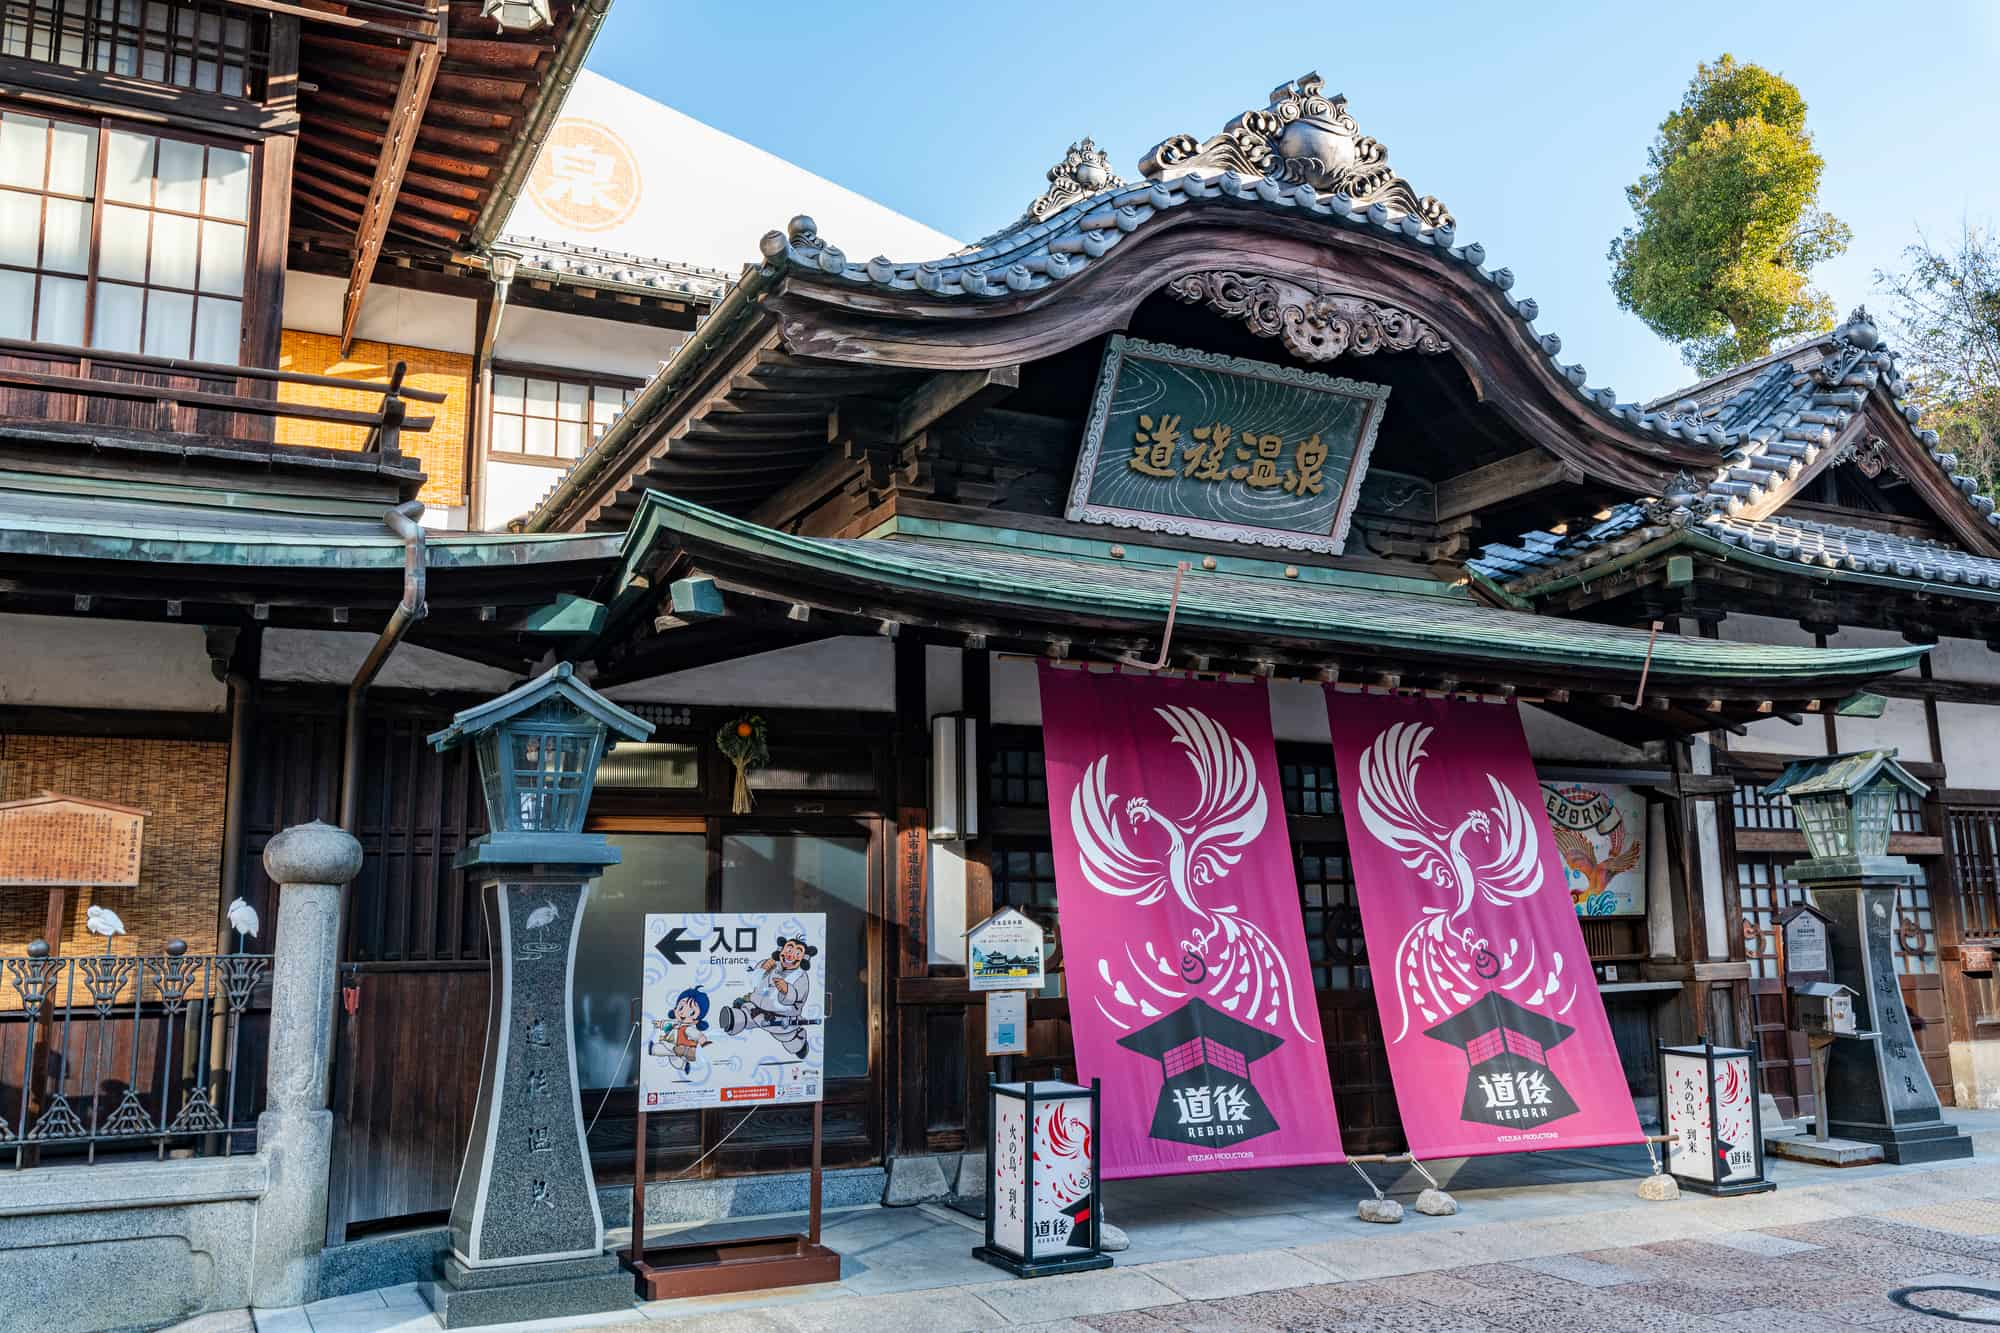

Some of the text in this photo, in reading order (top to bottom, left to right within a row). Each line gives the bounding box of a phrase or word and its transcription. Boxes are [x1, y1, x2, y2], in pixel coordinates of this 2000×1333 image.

[543, 143, 620, 212] 泉
[1129, 414, 1329, 497] 道後温泉
[1546, 795, 1604, 825] EBORN
[709, 926, 757, 953] 入口
[710, 955, 749, 965] Entrance
[1477, 1069, 1553, 1108] 道後
[1172, 1083, 1252, 1124] 道後
[1495, 1106, 1548, 1121] REBORN
[1187, 1124, 1245, 1139] REBORN
[1034, 1218, 1069, 1238] 道後
